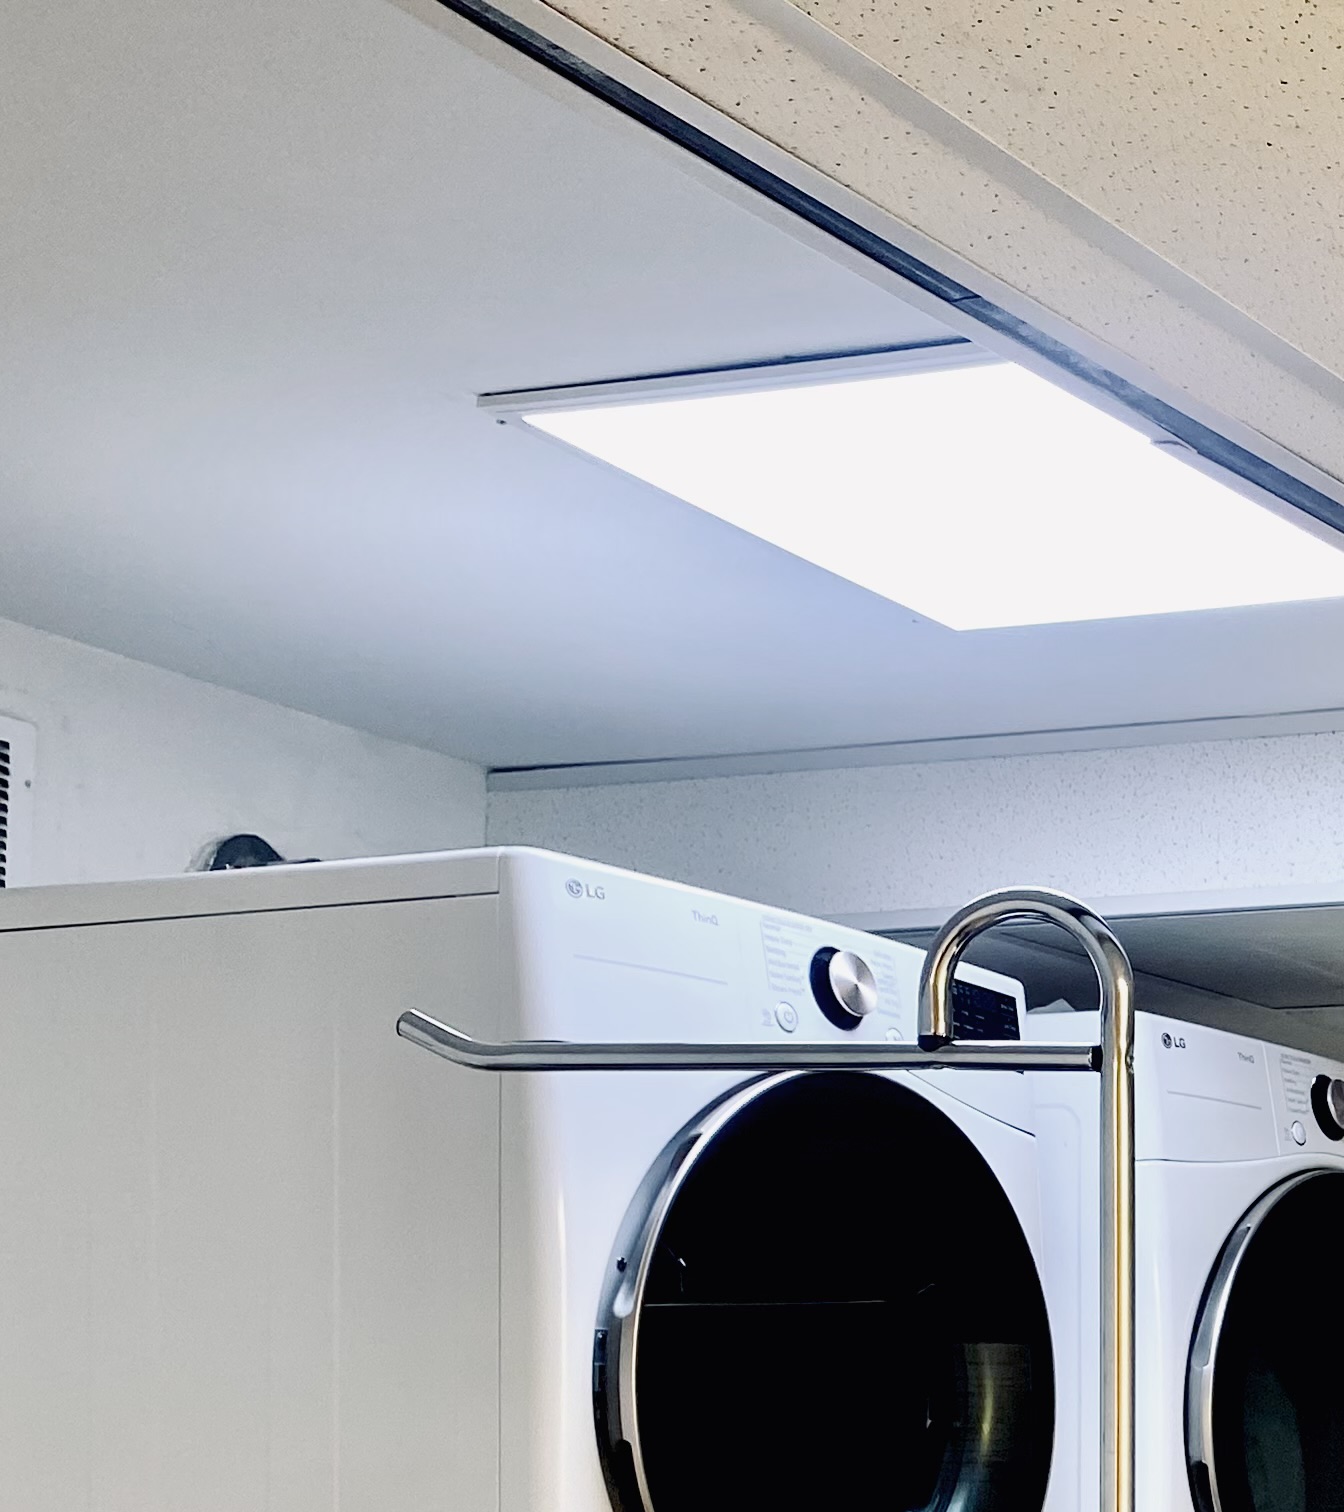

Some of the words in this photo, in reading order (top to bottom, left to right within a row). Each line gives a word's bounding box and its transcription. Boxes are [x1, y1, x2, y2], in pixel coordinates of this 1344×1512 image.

[586, 884, 605, 900] LG
[692, 910, 719, 926] ThinQ
[1173, 1036, 1186, 1049] LG
